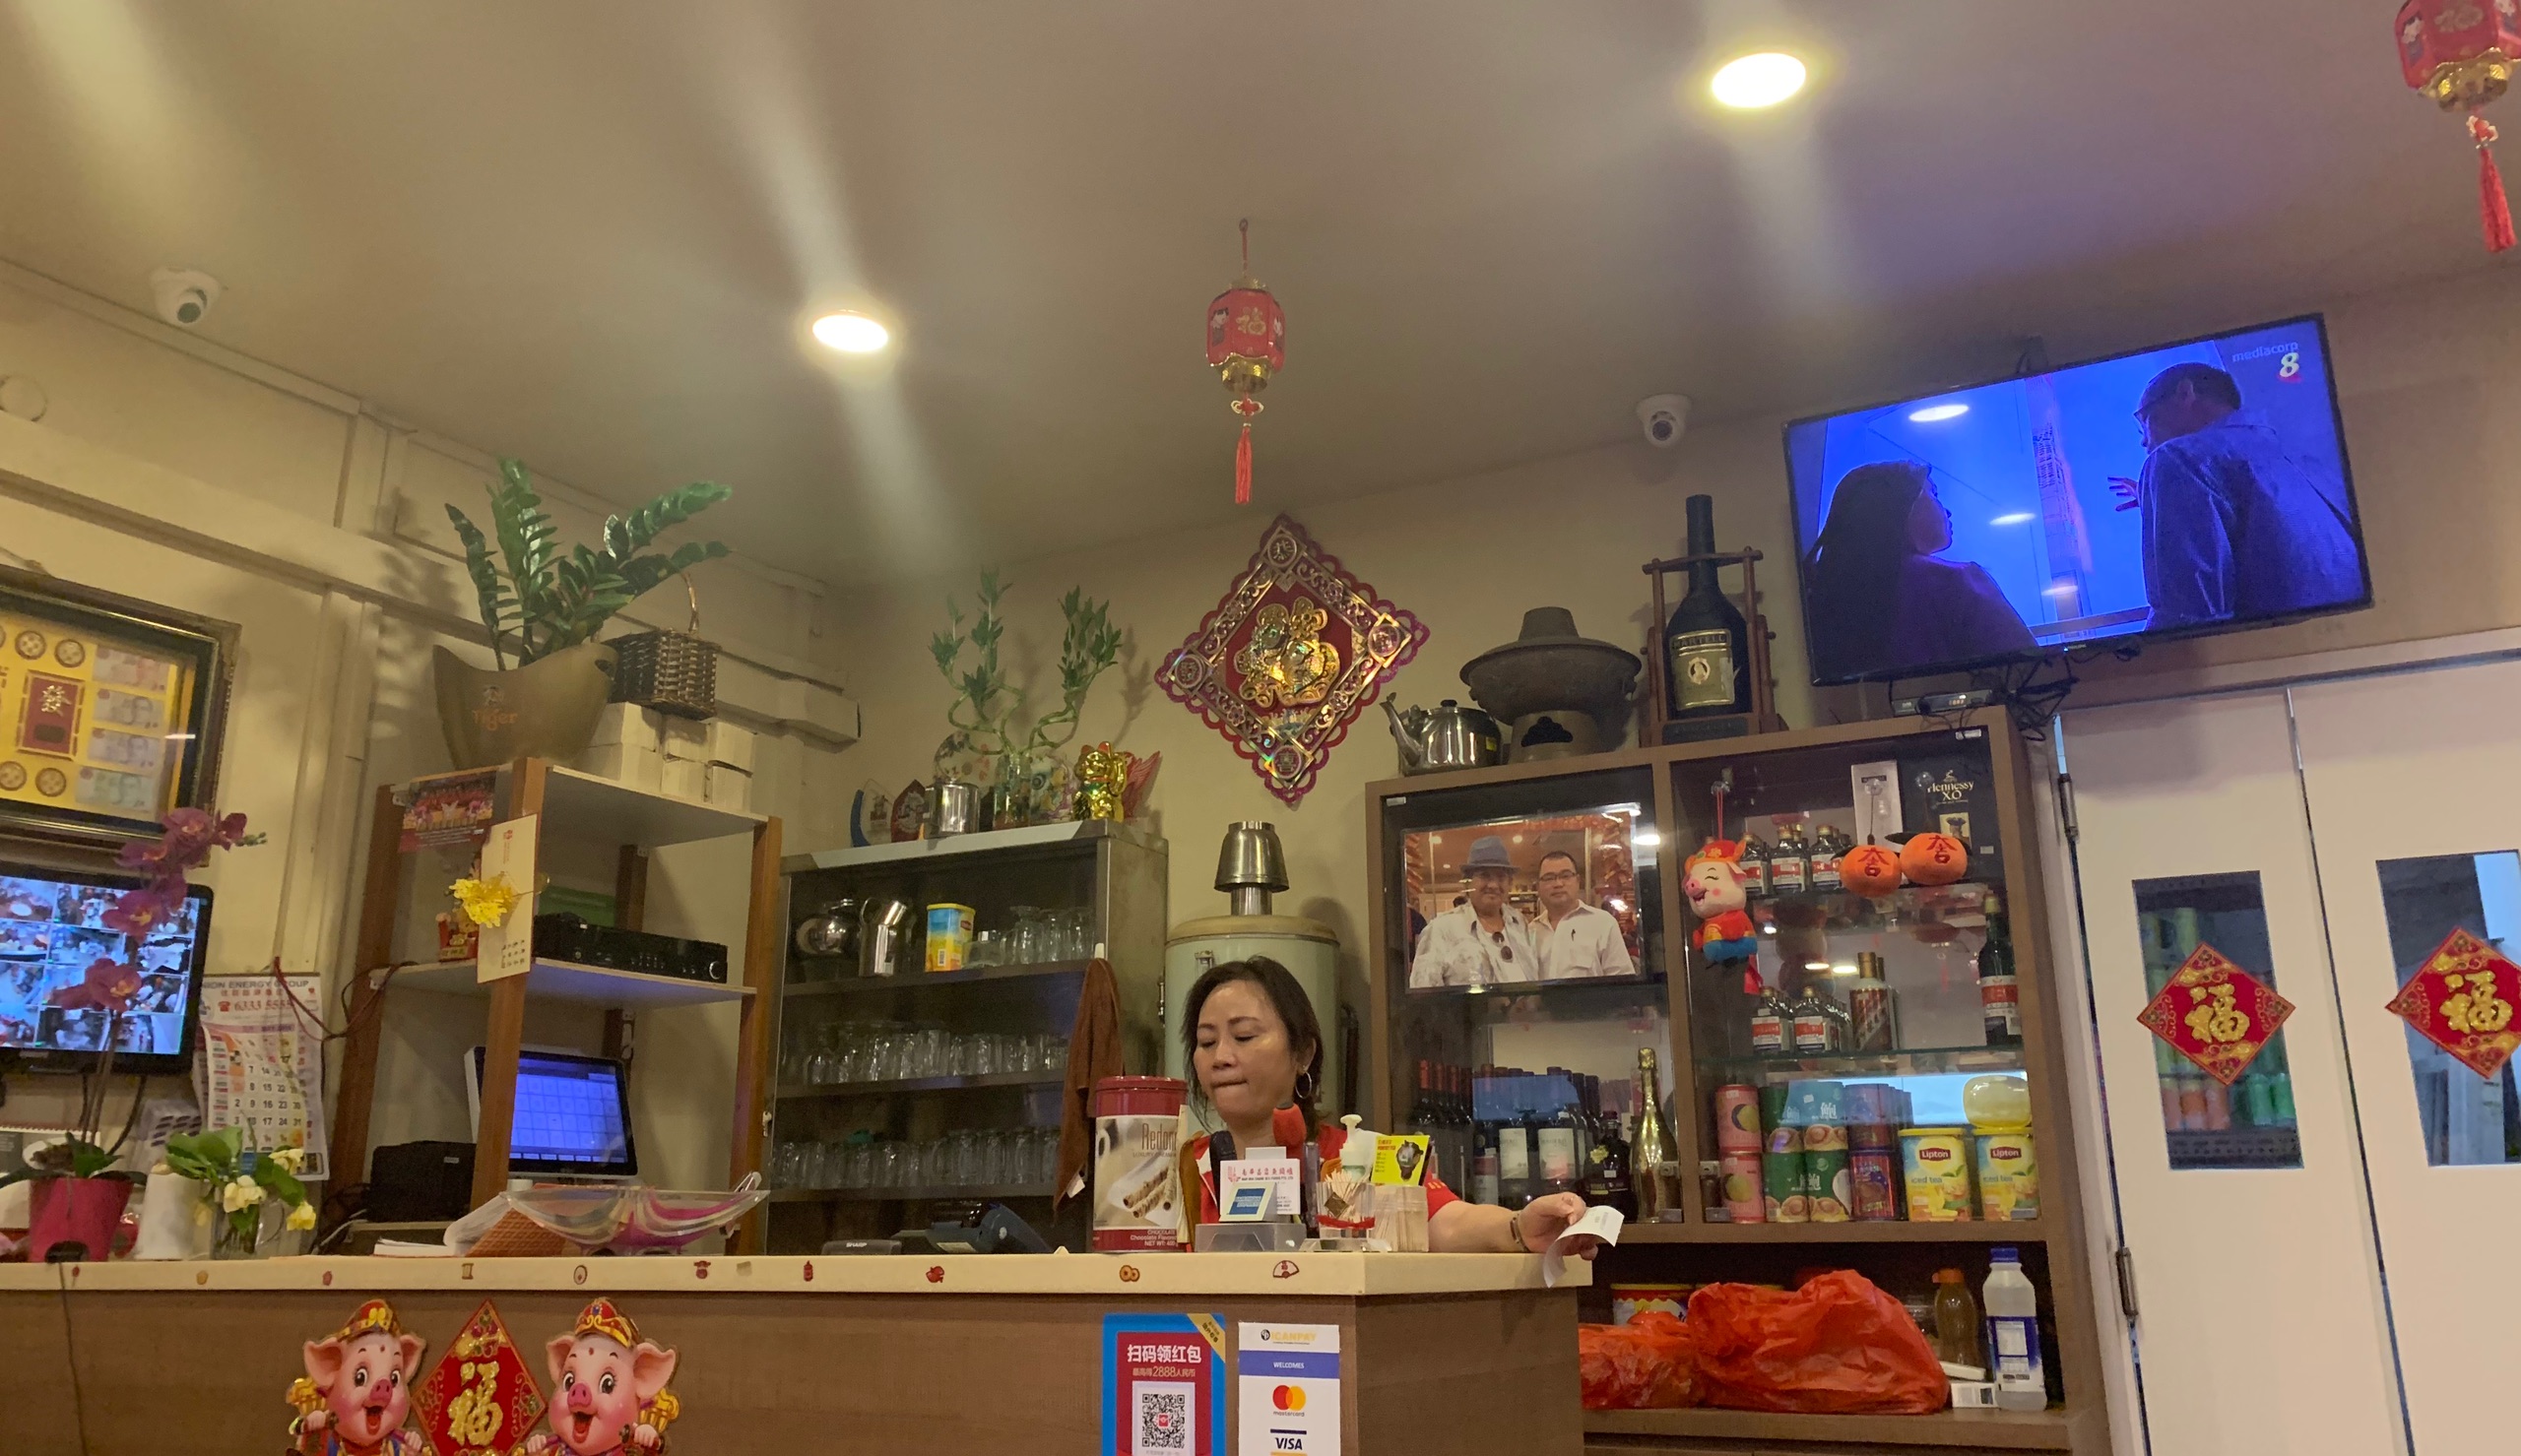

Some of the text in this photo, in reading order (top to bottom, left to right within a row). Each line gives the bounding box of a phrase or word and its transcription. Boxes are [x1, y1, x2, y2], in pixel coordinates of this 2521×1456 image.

[2231, 341, 2298, 362] mediacorp
[2279, 352, 2299, 378] 8
[2439, 970, 2513, 1034] 福
[2184, 982, 2250, 1044] 福
[1920, 1150, 1949, 1159] Lipton
[1991, 1149, 2020, 1158] Lipton
[1127, 1344, 1201, 1363] 扫码领红包
[1275, 1437, 1303, 1450] VISA
